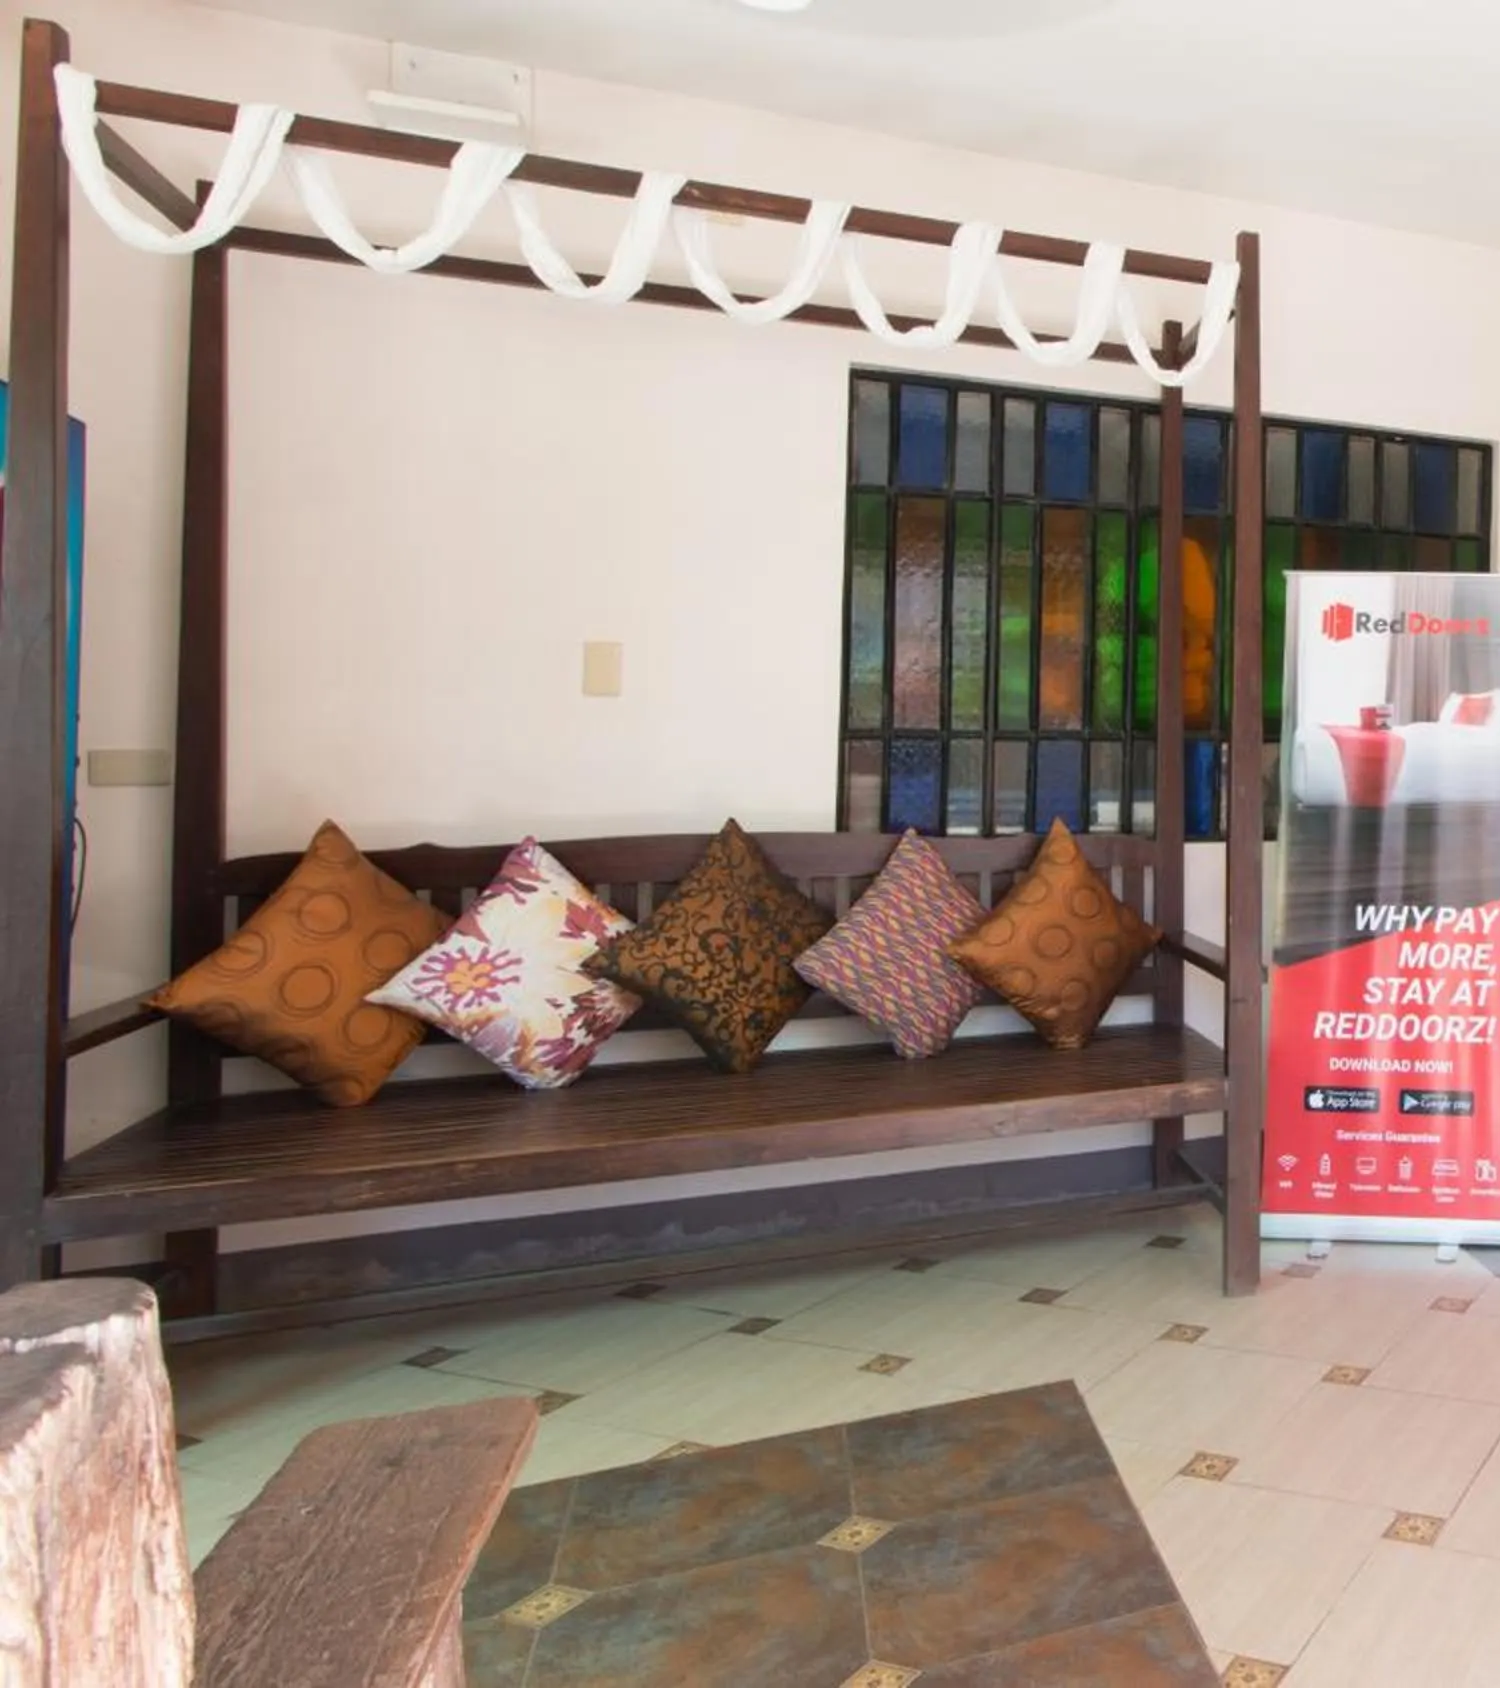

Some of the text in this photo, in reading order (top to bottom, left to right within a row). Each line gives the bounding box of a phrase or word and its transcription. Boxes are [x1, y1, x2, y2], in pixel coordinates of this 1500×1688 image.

[1355, 904, 1500, 935] WHY PAY
[1399, 941, 1497, 977] MORE,
[1363, 977, 1497, 1008] STAY AT
[1313, 1011, 1498, 1044] REDDOORZ!
[1329, 1056, 1454, 1074] DOWNLOAD NOW!
[1326, 1096, 1349, 1110] App
